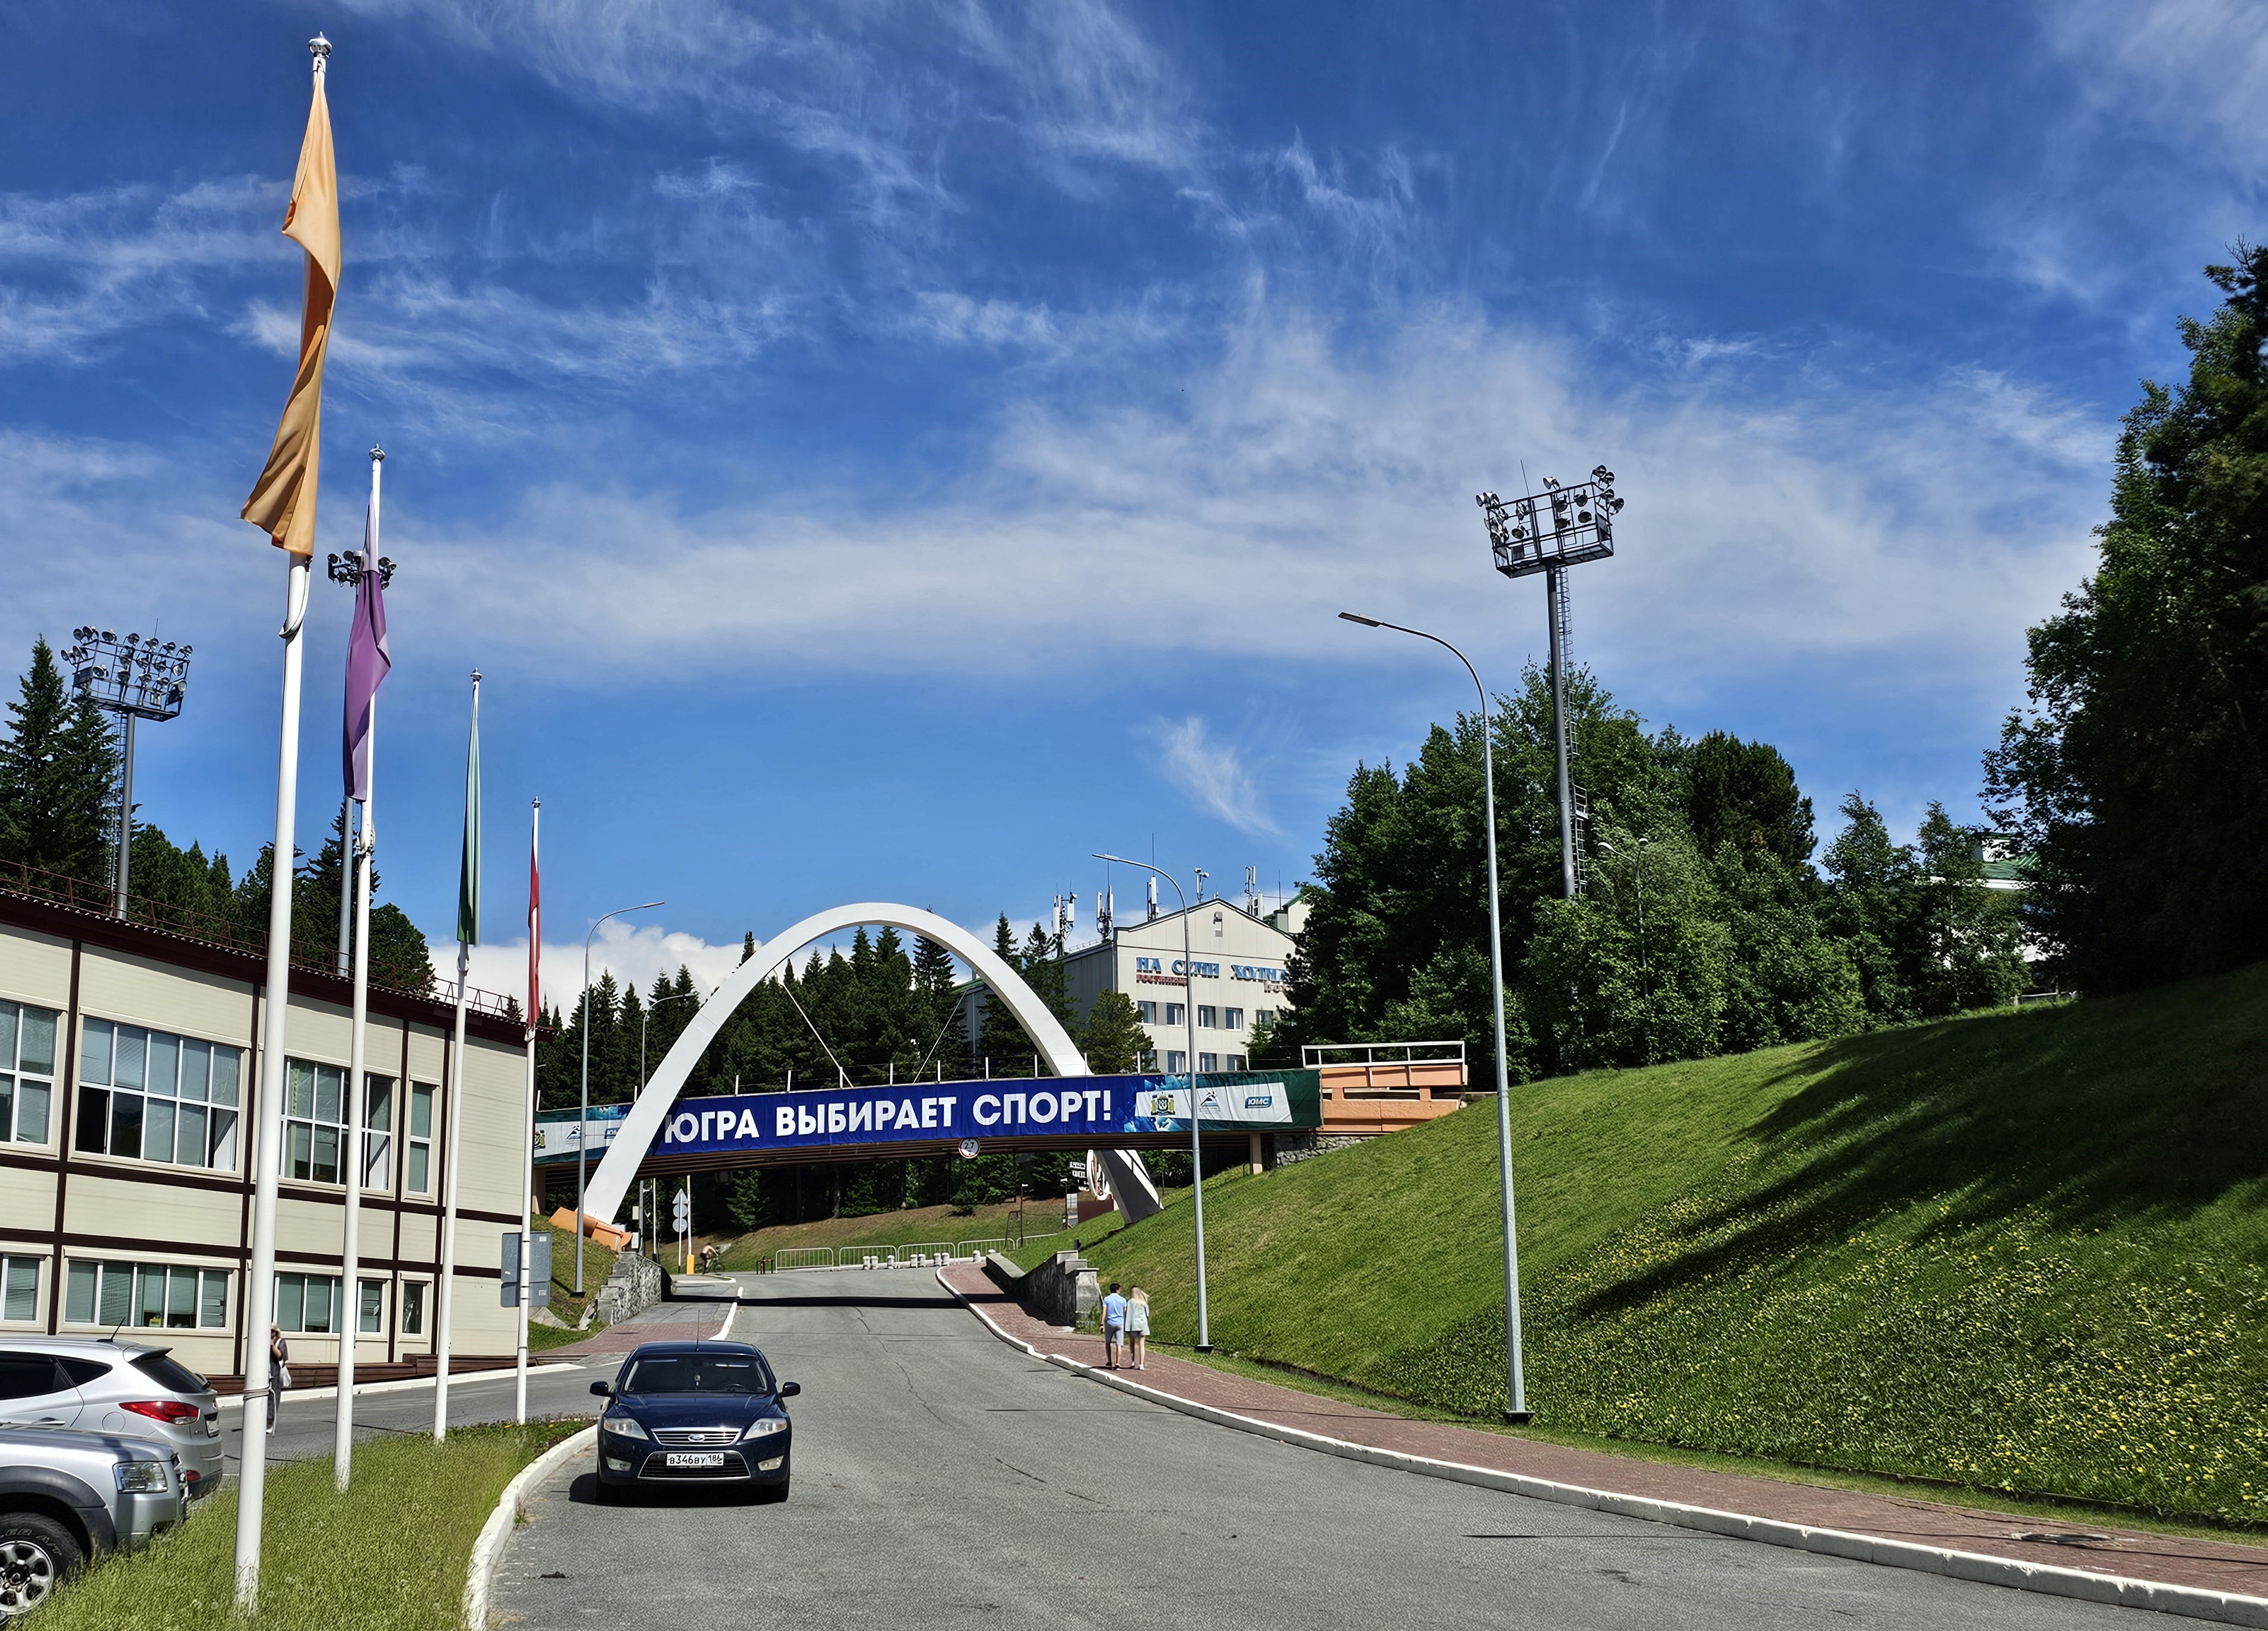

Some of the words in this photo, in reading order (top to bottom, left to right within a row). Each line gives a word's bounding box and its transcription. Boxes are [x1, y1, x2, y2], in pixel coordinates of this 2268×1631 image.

[1136, 957, 1162, 974] НА
[664, 1108, 760, 1144] ЮГРА
[776, 1096, 957, 1137] ВЫБИРАЕТ
[972, 1090, 1111, 1126] СПОРТ!
